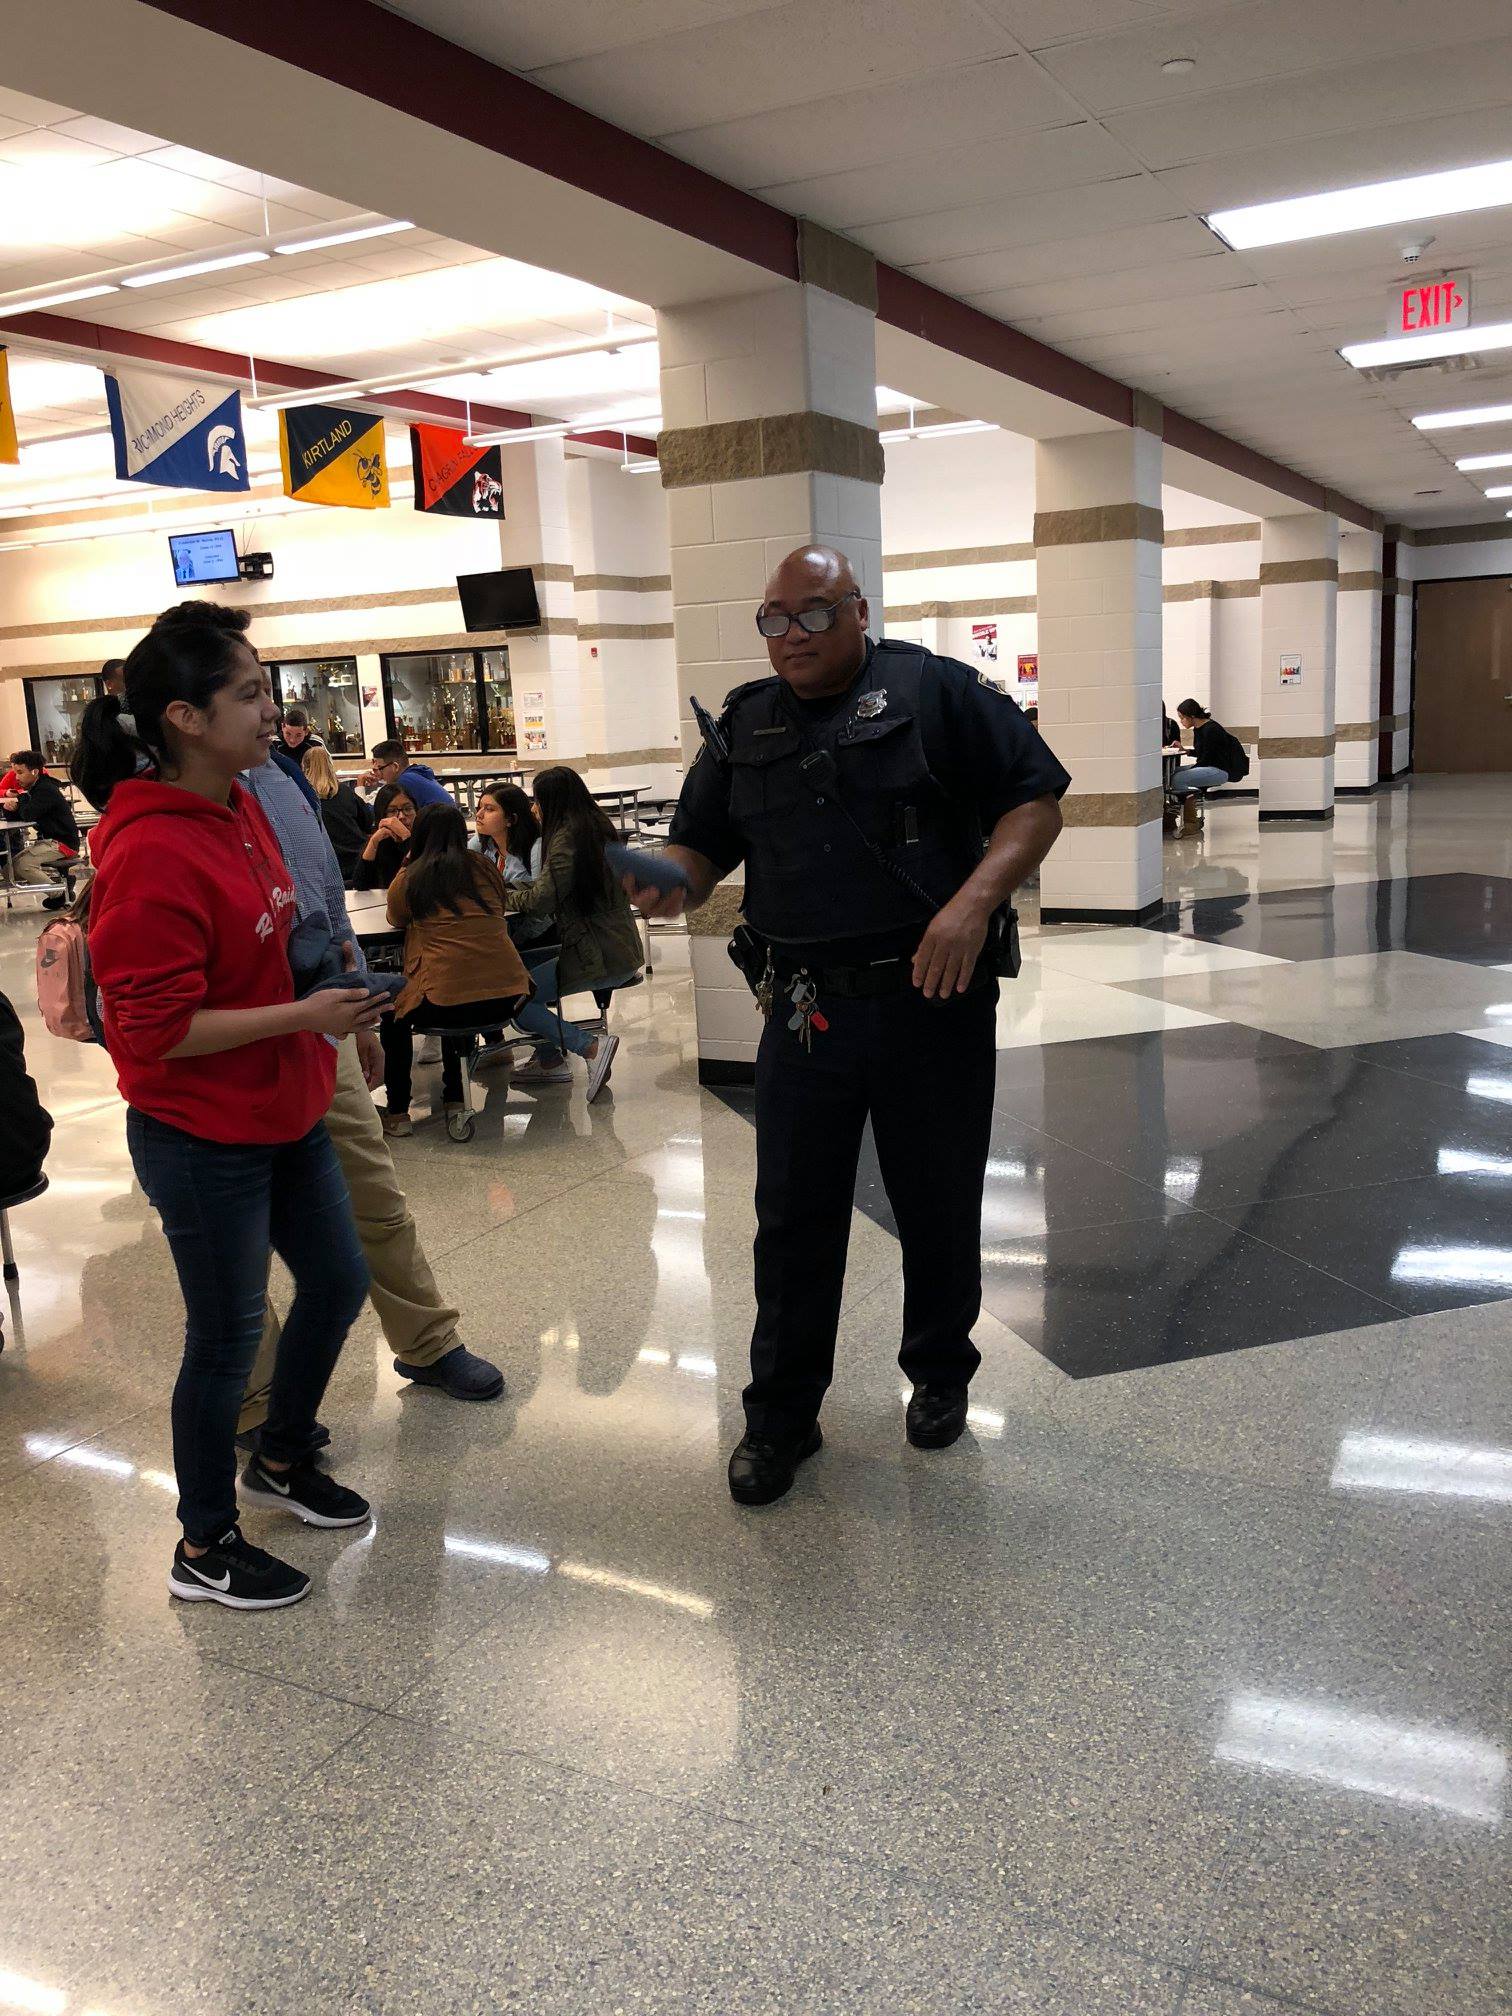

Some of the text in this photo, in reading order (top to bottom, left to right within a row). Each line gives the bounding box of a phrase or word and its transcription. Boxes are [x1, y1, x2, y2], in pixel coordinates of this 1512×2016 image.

[1402, 281, 1456, 331] EXIT
[131, 389, 206, 454] RICHMOND HEIGHTS
[301, 420, 352, 469] KIRTLAND
